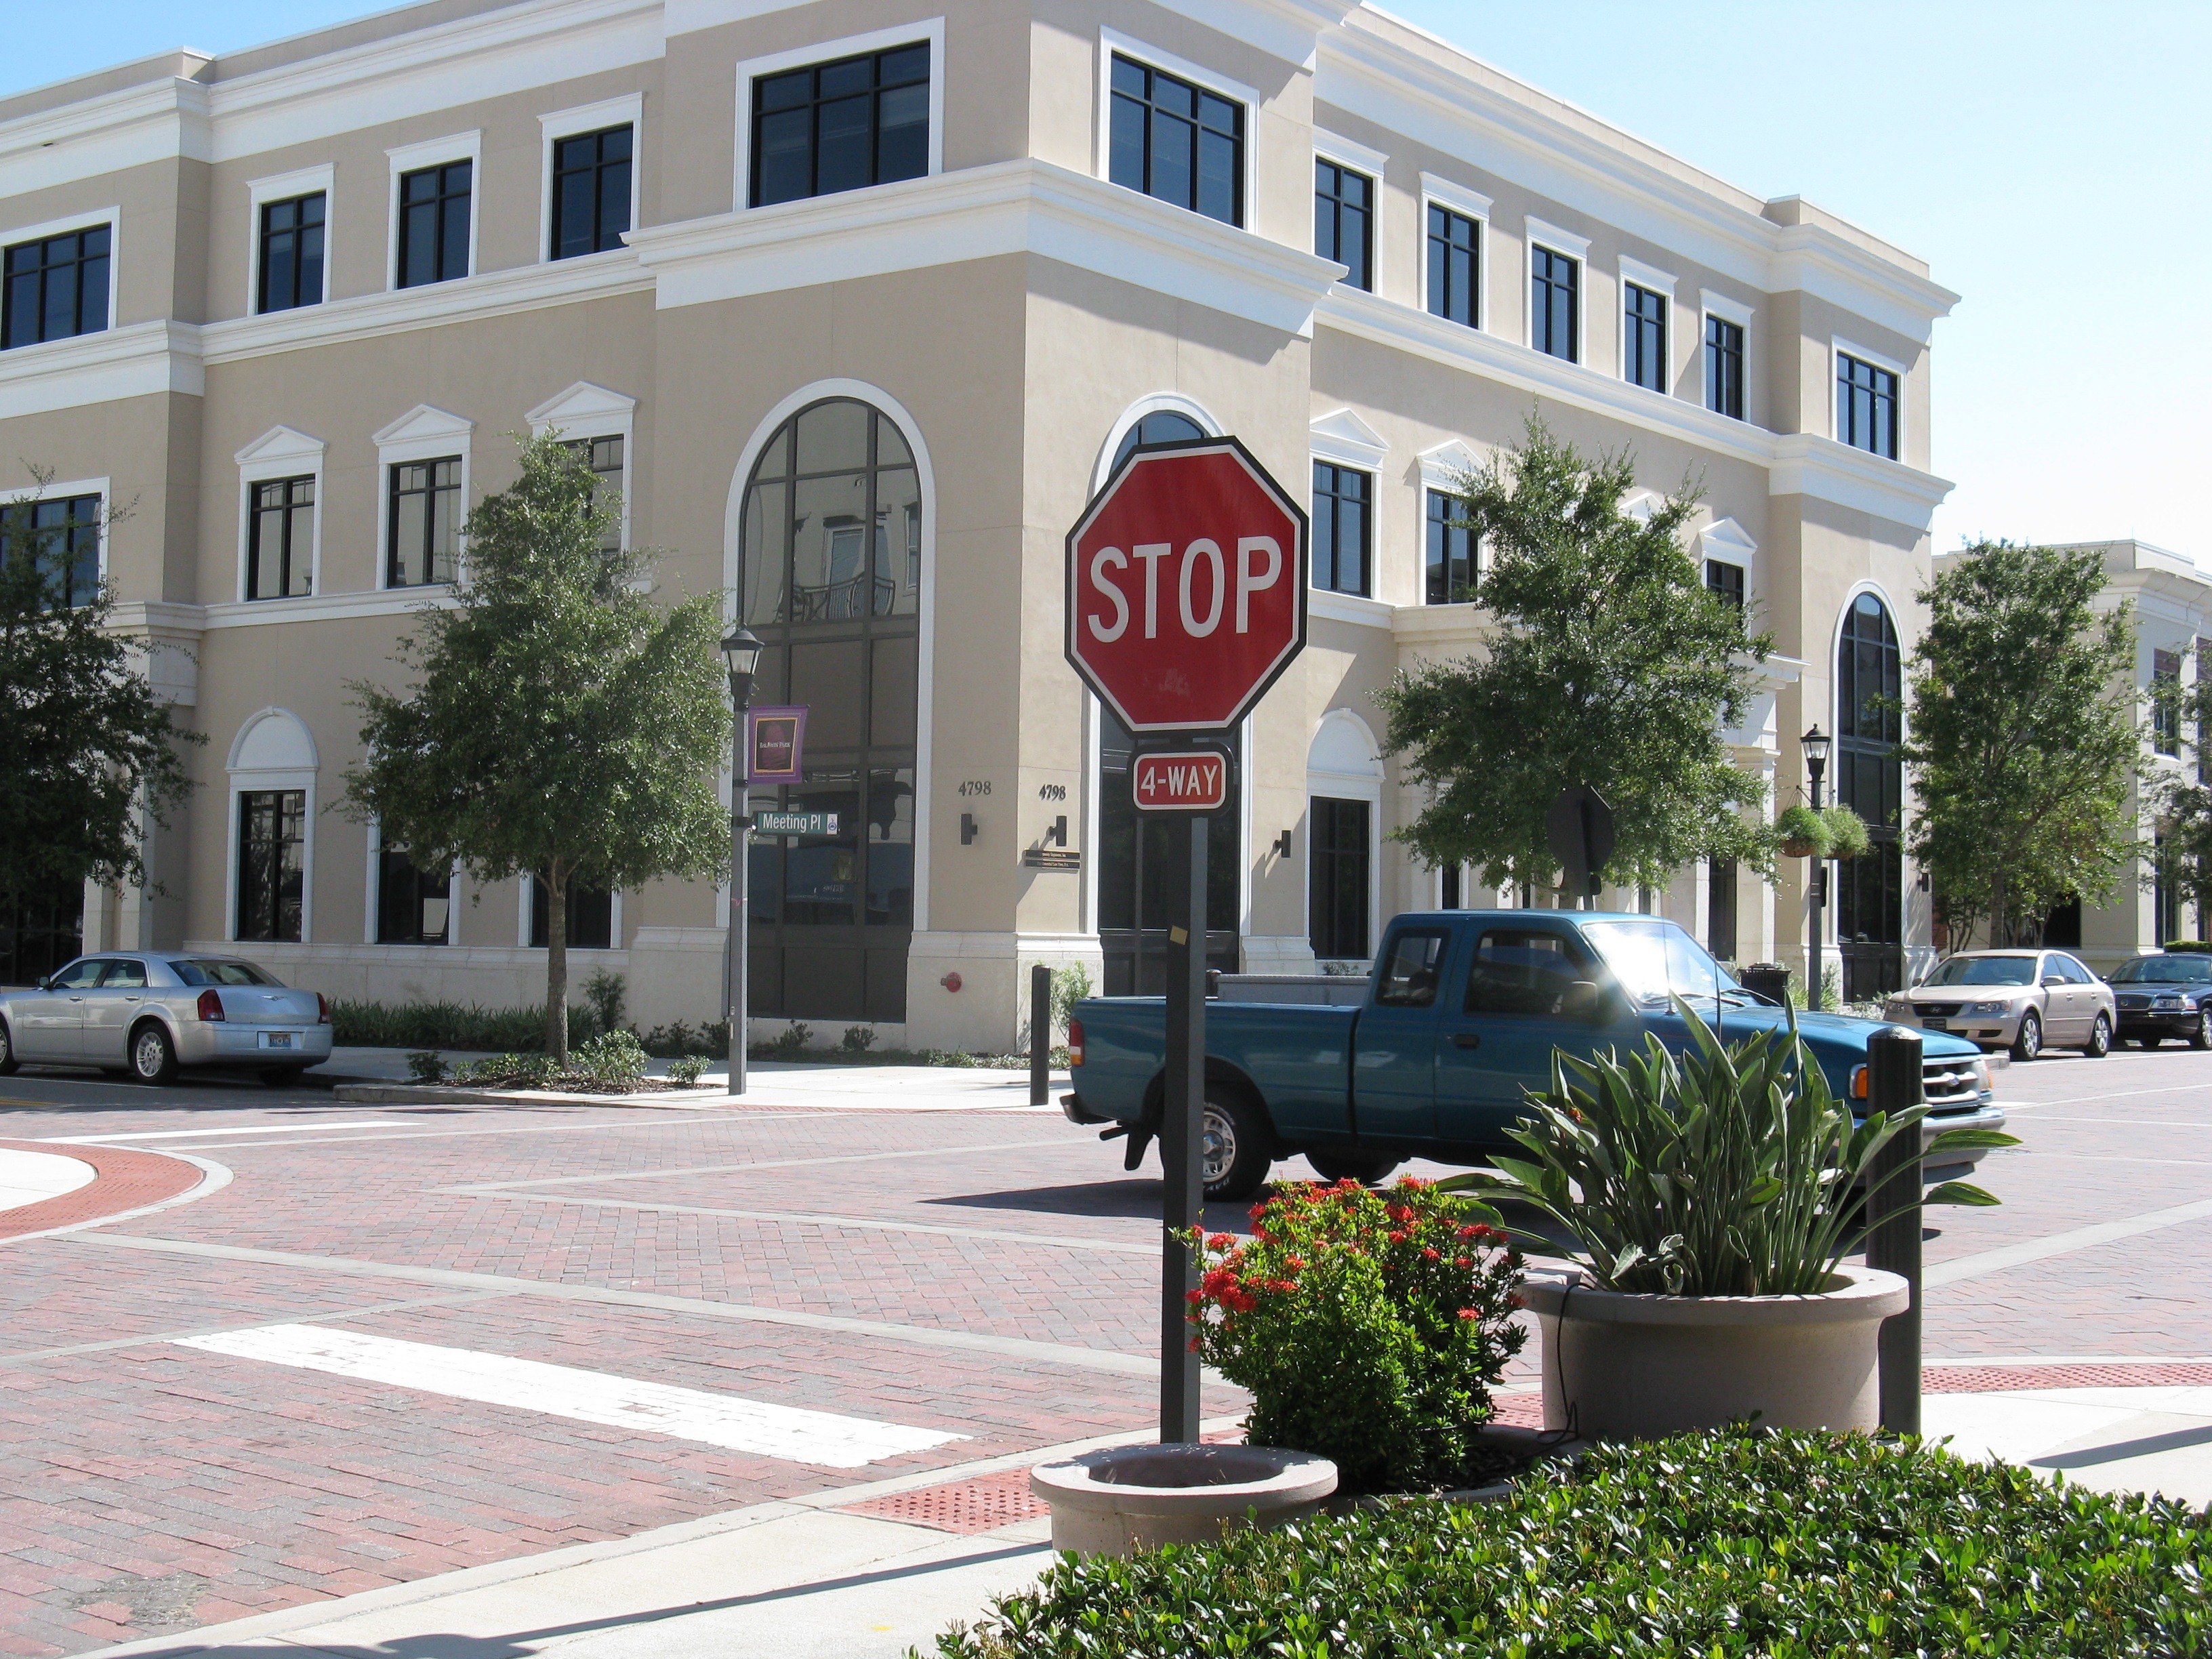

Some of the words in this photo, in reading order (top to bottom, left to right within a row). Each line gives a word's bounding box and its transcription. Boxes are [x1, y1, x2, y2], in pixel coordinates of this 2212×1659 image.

[1087, 535, 1282, 643] STOP
[958, 781, 992, 796] 4798
[1140, 764, 1218, 797] 4-WAY
[1038, 784, 1067, 800] 4798
[762, 813, 807, 833] Meeting
[810, 814, 821, 830] Pl
